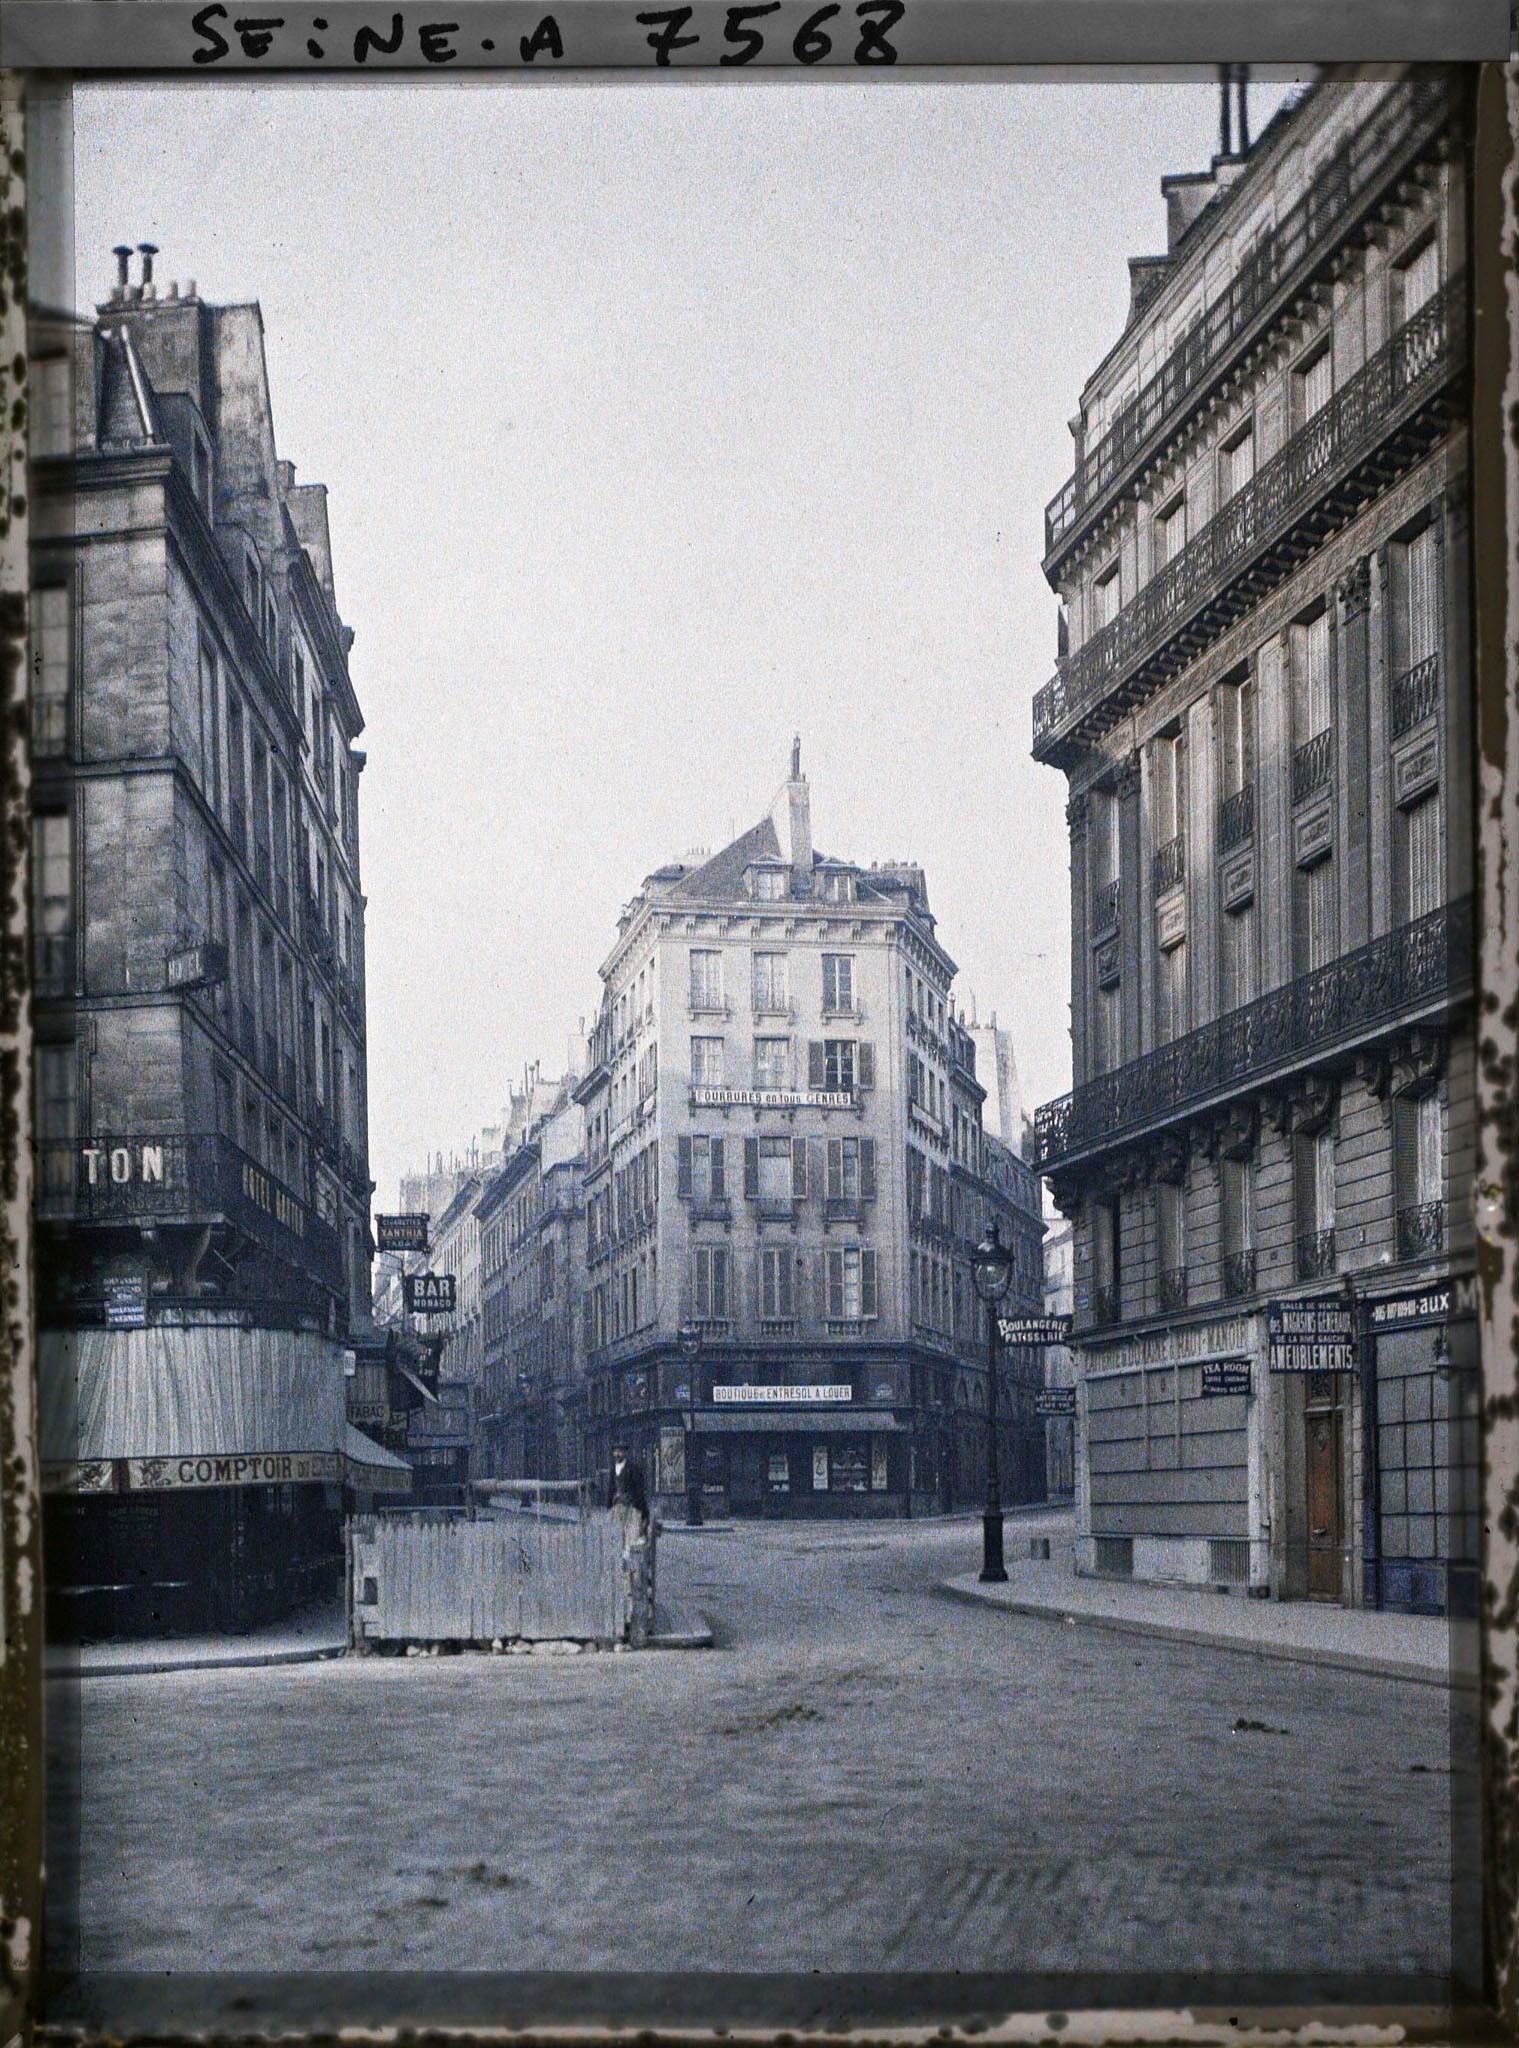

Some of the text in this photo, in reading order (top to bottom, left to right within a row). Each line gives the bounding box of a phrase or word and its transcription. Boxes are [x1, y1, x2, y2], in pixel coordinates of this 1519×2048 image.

[637, 2, 905, 65] 7568
[698, 1090, 762, 1103] OURRURES
[381, 1228, 424, 1238] XANTHIA
[414, 1279, 450, 1297] BAR
[413, 1299, 452, 1308] MONACO
[1420, 1292, 1450, 1314] aux
[998, 1319, 1069, 1337] BOULANGERIE
[1288, 1335, 1298, 1343] LA
[1270, 1345, 1353, 1369] AMEUBLEMENTS
[1203, 1362, 1249, 1374] TEA ROOM
[715, 1387, 758, 1399] BOUTIQUE
[767, 1387, 811, 1399] ENTRESOL
[823, 1387, 850, 1398] LOUER
